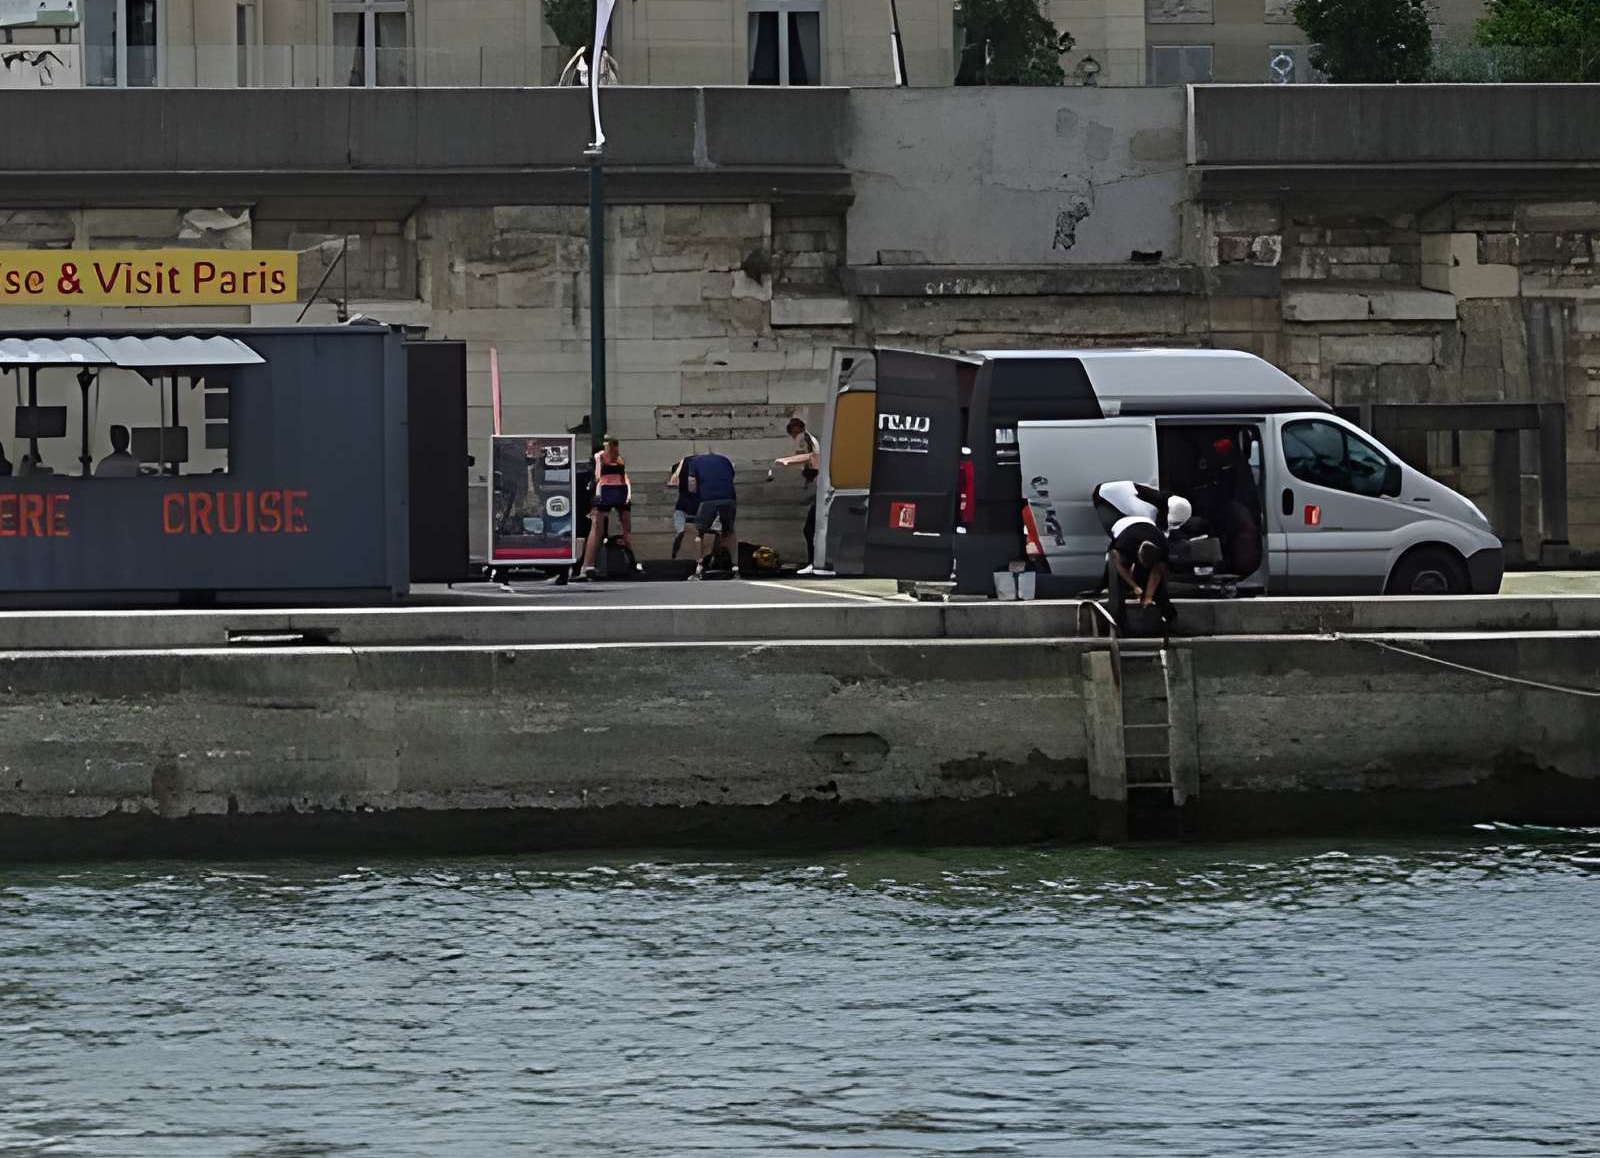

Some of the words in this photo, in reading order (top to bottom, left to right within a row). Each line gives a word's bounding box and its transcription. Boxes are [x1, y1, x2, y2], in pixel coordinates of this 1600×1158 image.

[57, 261, 84, 295] &
[92, 261, 182, 295] Visit
[193, 260, 286, 295] Paris
[162, 491, 309, 534] CRUISE
